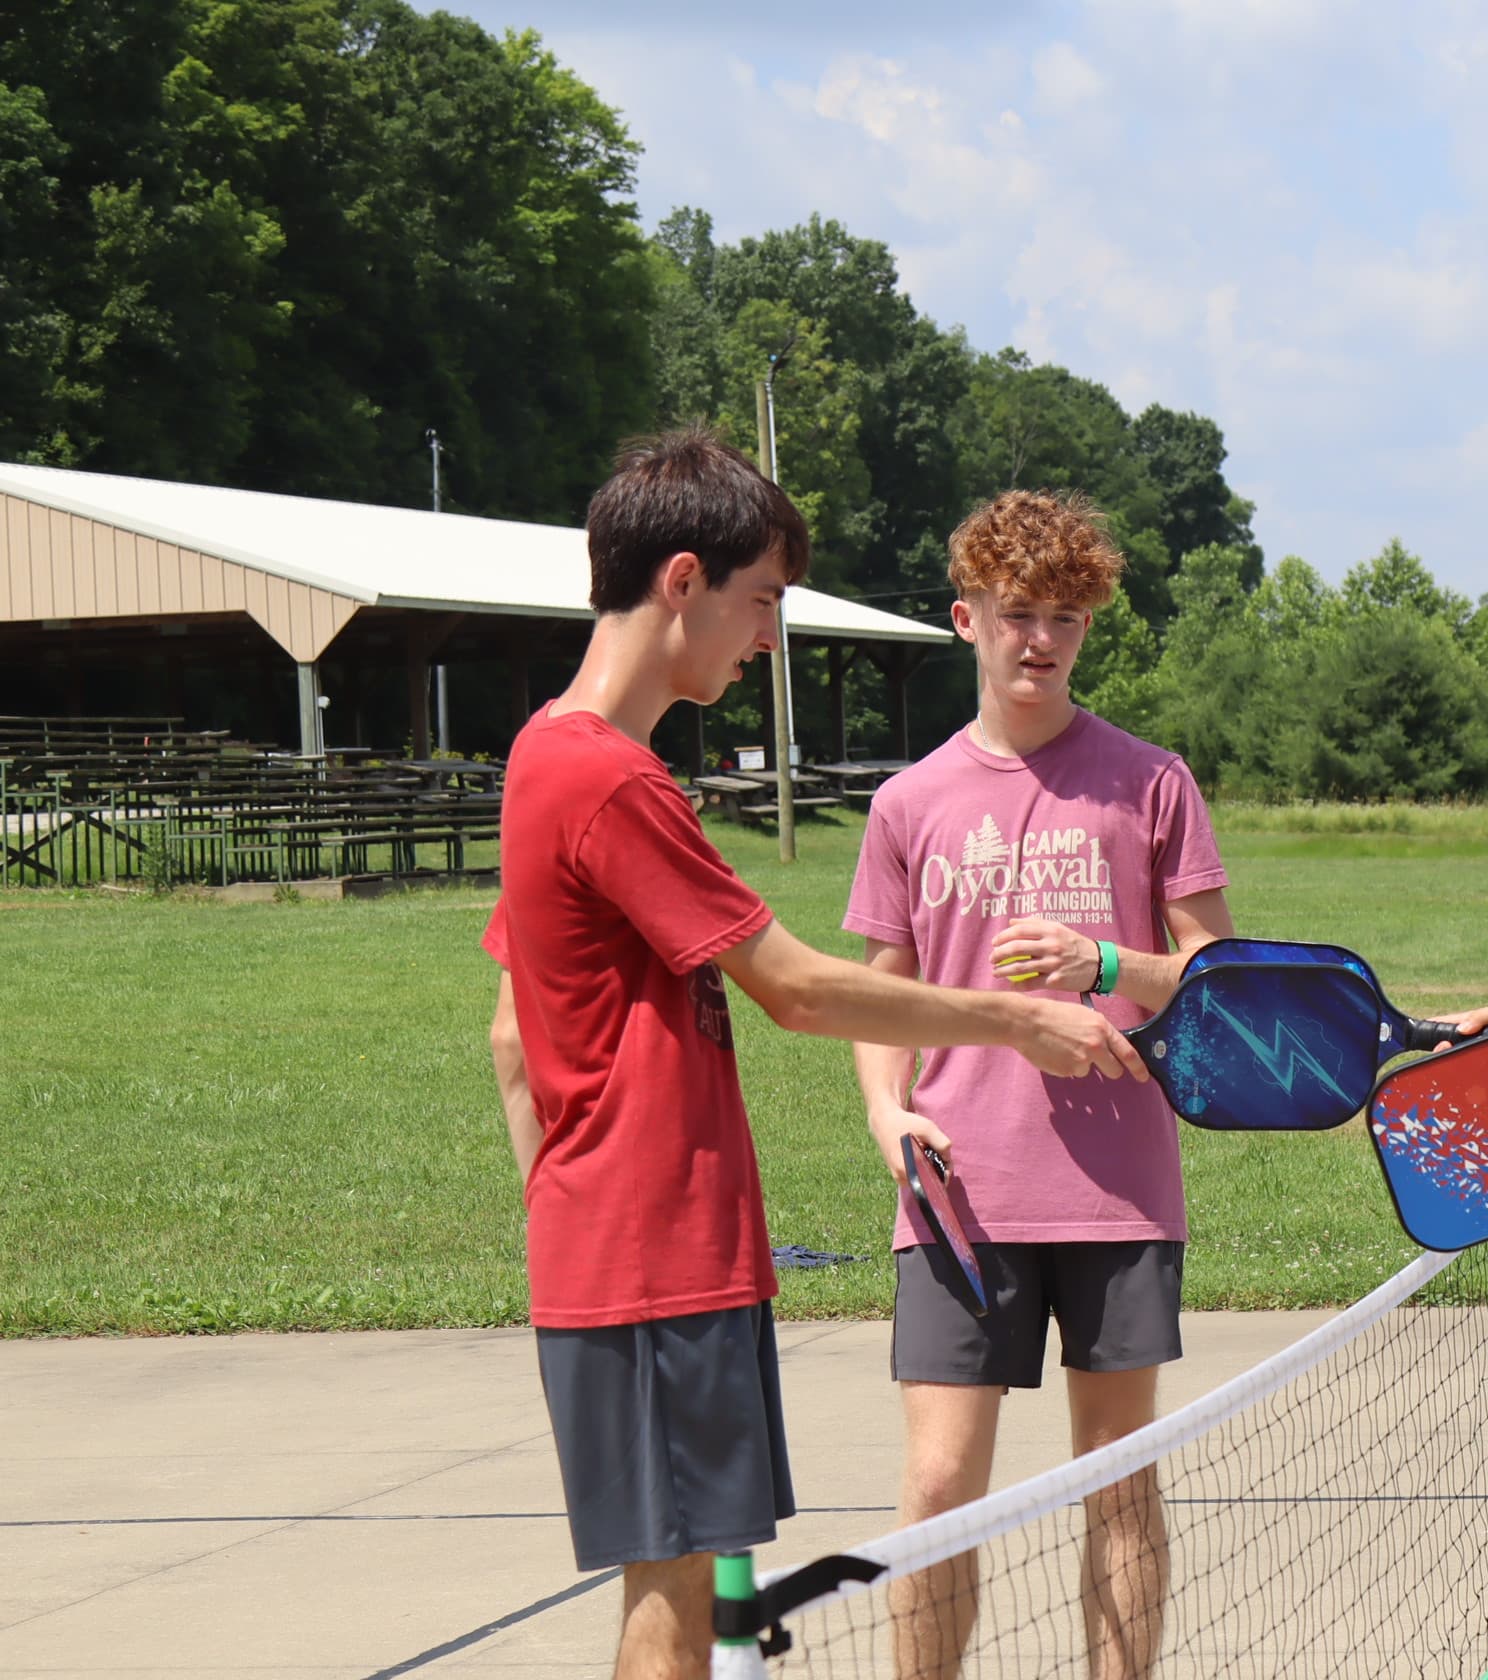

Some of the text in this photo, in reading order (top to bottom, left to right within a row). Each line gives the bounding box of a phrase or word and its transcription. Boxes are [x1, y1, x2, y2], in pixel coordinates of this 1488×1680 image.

[1023, 828, 1086, 857] CAMP
[981, 891, 1112, 919] FOR THE KINGDOM
[1085, 912, 1112, 924] 1:13-14
